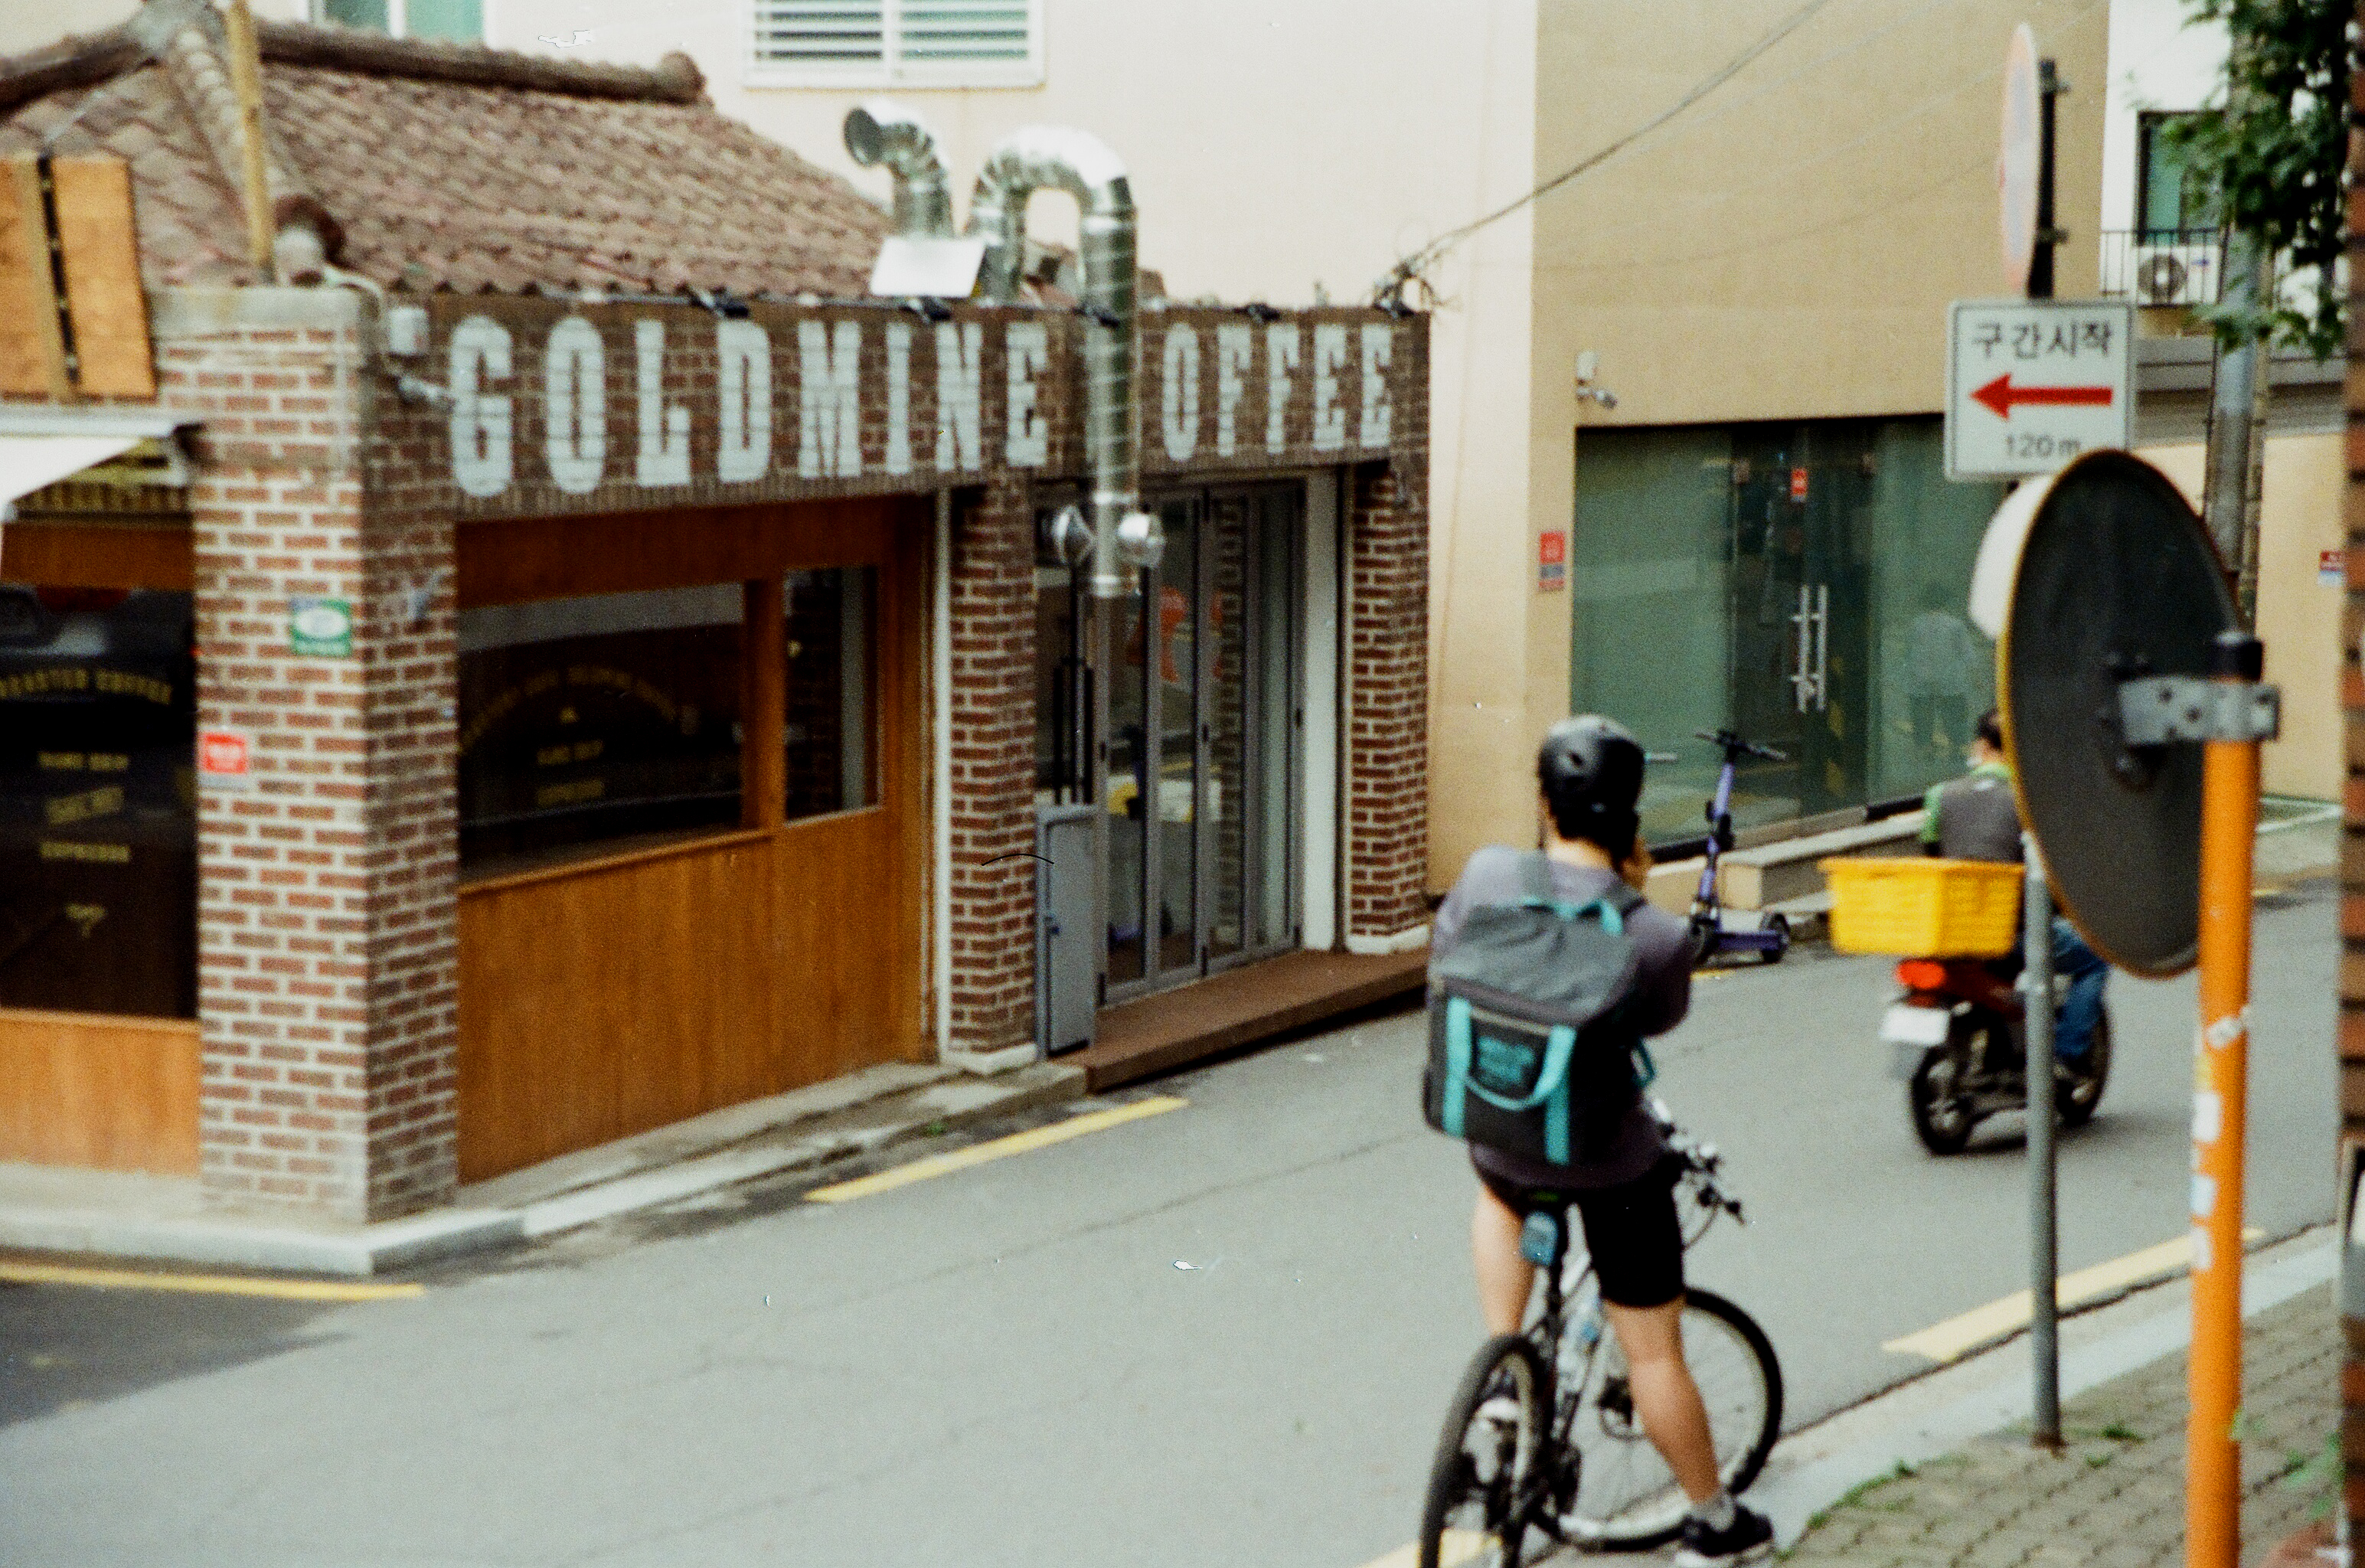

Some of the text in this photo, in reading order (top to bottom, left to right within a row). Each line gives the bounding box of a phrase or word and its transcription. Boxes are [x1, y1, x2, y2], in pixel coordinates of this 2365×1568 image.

[1972, 320, 2112, 360] 구간시작
[449, 315, 1392, 496] GOLDMINE OFFEE
